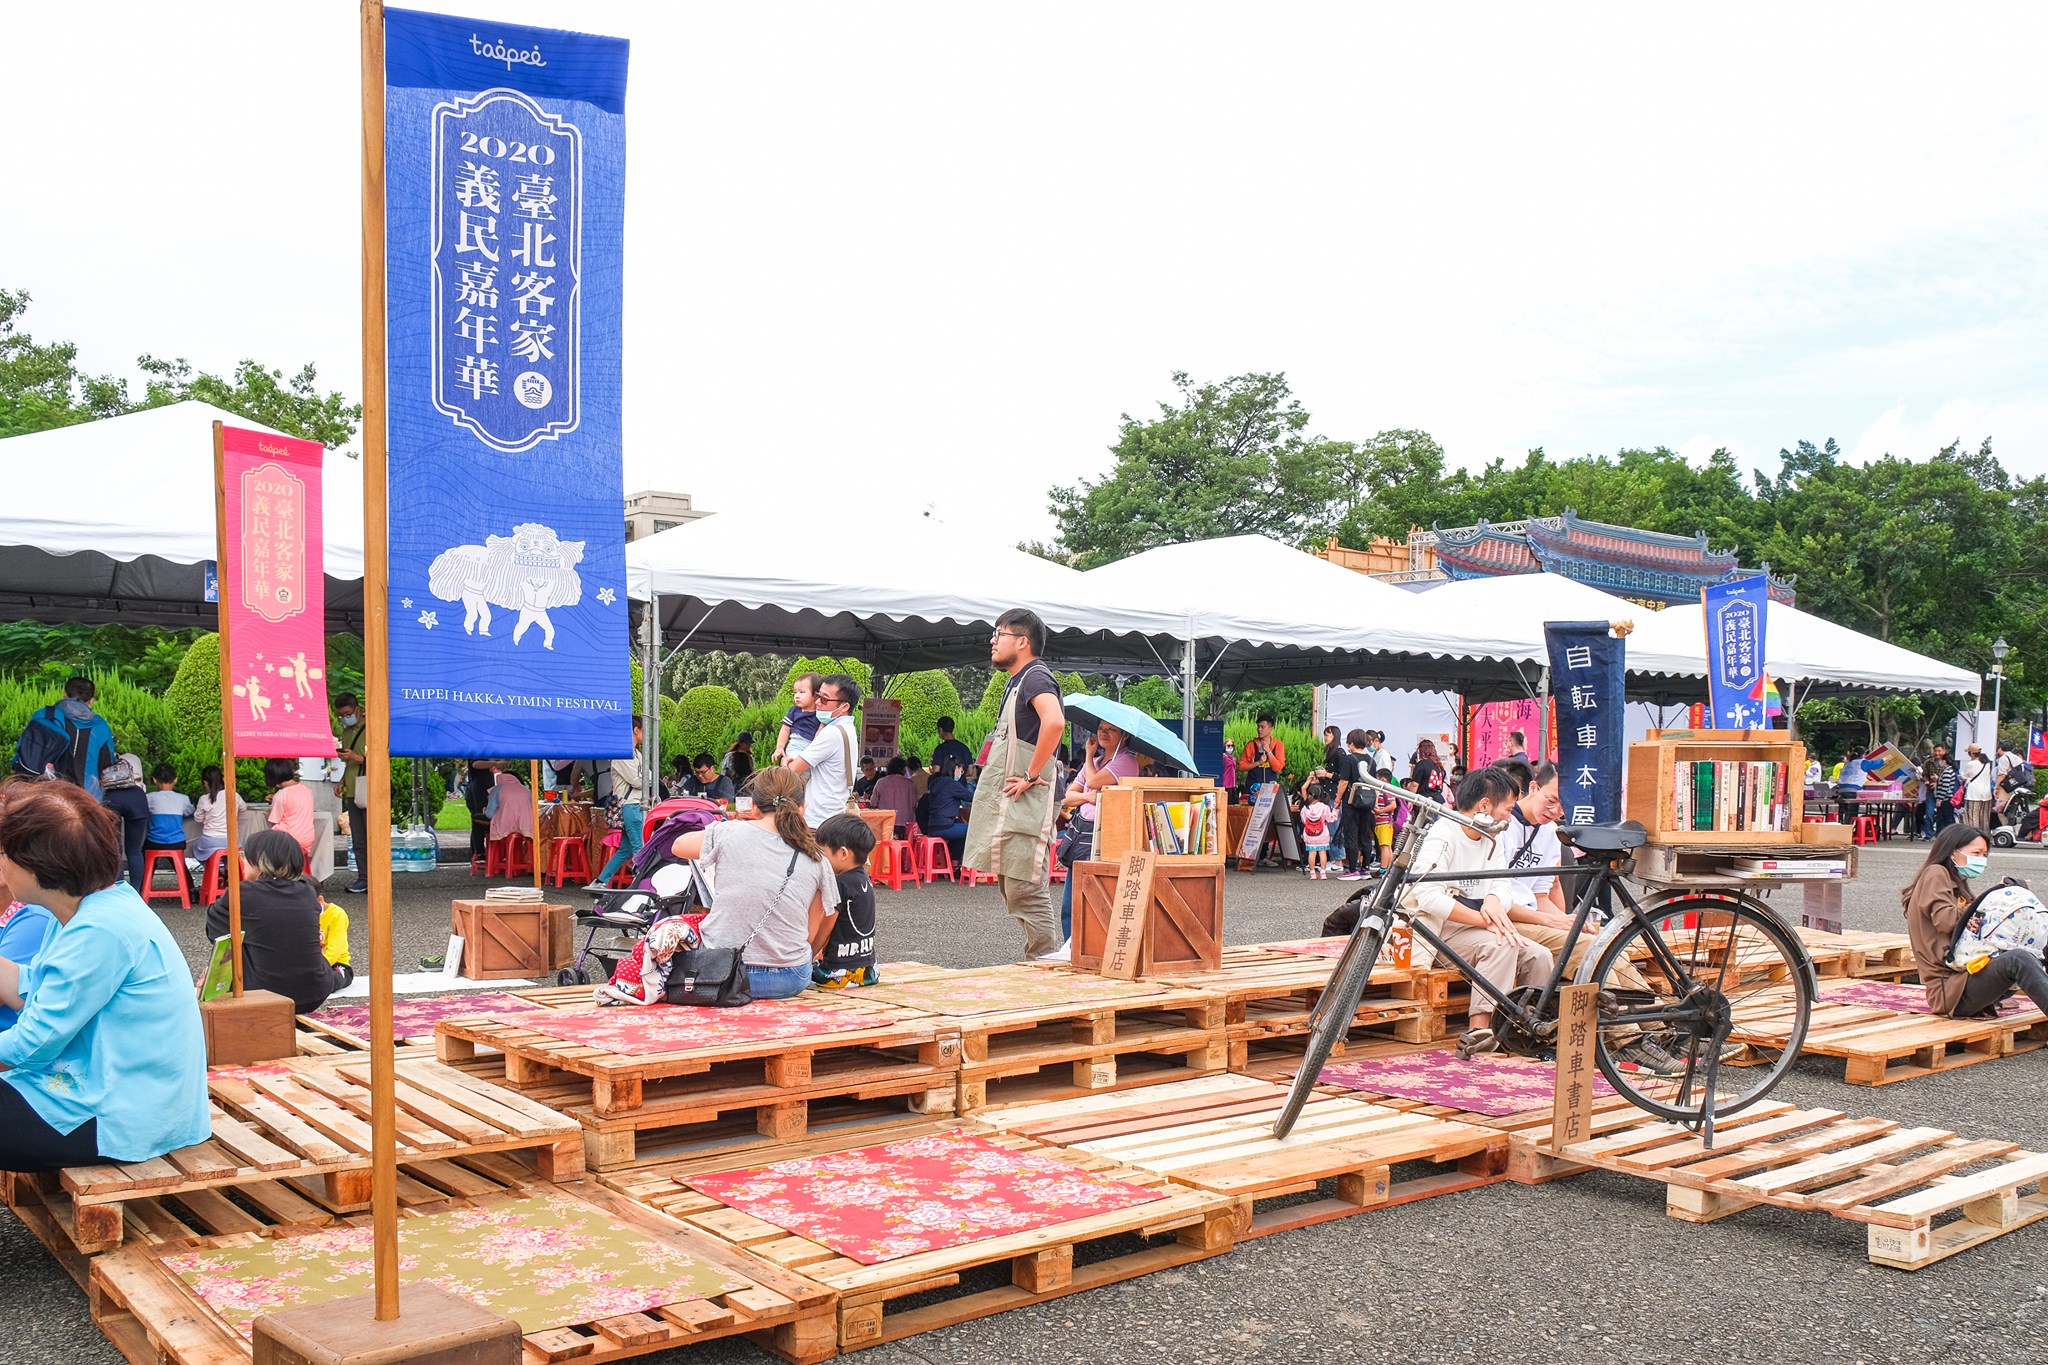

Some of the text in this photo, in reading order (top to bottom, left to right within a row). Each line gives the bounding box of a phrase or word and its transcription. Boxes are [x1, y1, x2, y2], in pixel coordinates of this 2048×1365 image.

[469, 33, 547, 70] taipei
[460, 132, 555, 166] 2020
[454, 160, 500, 400] 義民嘉年華
[510, 173, 558, 363] 臺北客家
[258, 442, 290, 457] taipei
[254, 480, 293, 496] 2020
[252, 495, 270, 600] 義民嘉年華
[274, 499, 295, 582] 臺北客家
[1725, 609, 1750, 619] 2020
[1725, 619, 1739, 679] 義民嘉年華
[1738, 617, 1752, 664] 臺北客家
[402, 688, 622, 711] TAIPEI HAKKA YIMIN FESTIVAL
[1566, 645, 1598, 825] 自転車本屋
